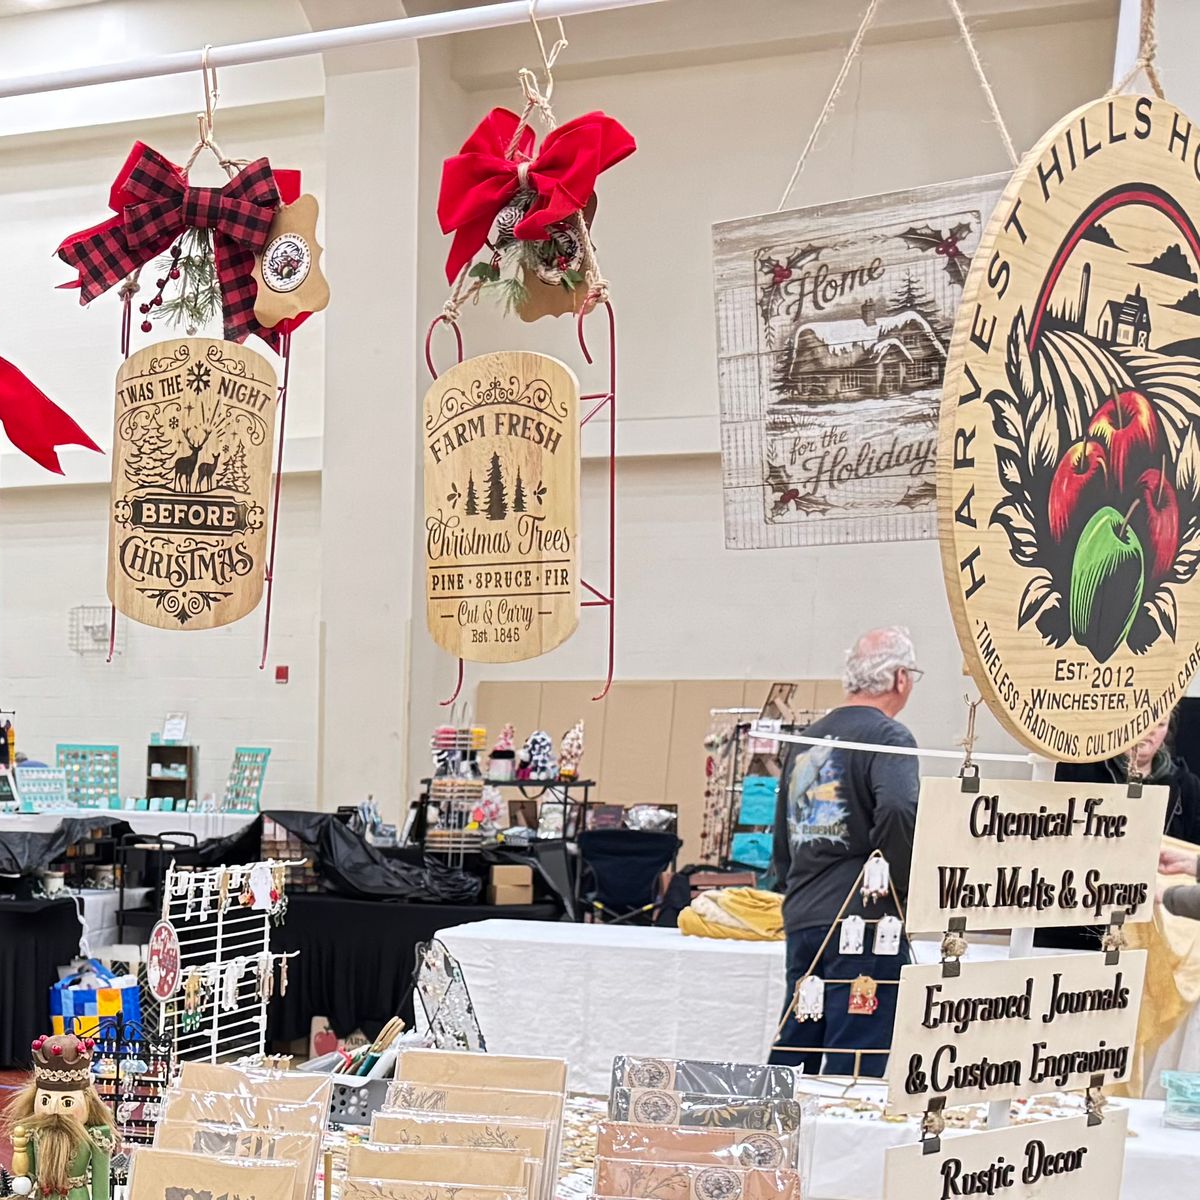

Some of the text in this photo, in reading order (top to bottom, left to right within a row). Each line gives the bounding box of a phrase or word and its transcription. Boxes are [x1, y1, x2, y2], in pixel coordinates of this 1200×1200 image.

[784, 257, 885, 322] Home
[953, 197, 1028, 600] HARVEST
[1036, 97, 1152, 202] HILLS
[159, 374, 184, 398] THE
[217, 380, 272, 413] NIGHT
[429, 412, 563, 464] FARM FRESH
[821, 429, 848, 449] the
[141, 504, 238, 528] BEFORE
[425, 508, 571, 560] Christmas Trees
[119, 535, 255, 588] CHRISTMAS
[431, 568, 570, 591] PINE SPRUCE FIR
[483, 602, 494, 625] &
[1091, 666, 1134, 688] 2012
[1133, 688, 1151, 709] VA
[1086, 710, 1150, 756] CULTIVATED
[1150, 682, 1177, 722] WITH
[969, 795, 1128, 842] Chemical-Free
[937, 865, 1148, 917] Wax Melts & Sprays
[921, 973, 1130, 1033] Engraved Journals
[905, 1040, 1130, 1095] & Custom Engraving
[940, 1139, 1088, 1200] Rustic Decor
